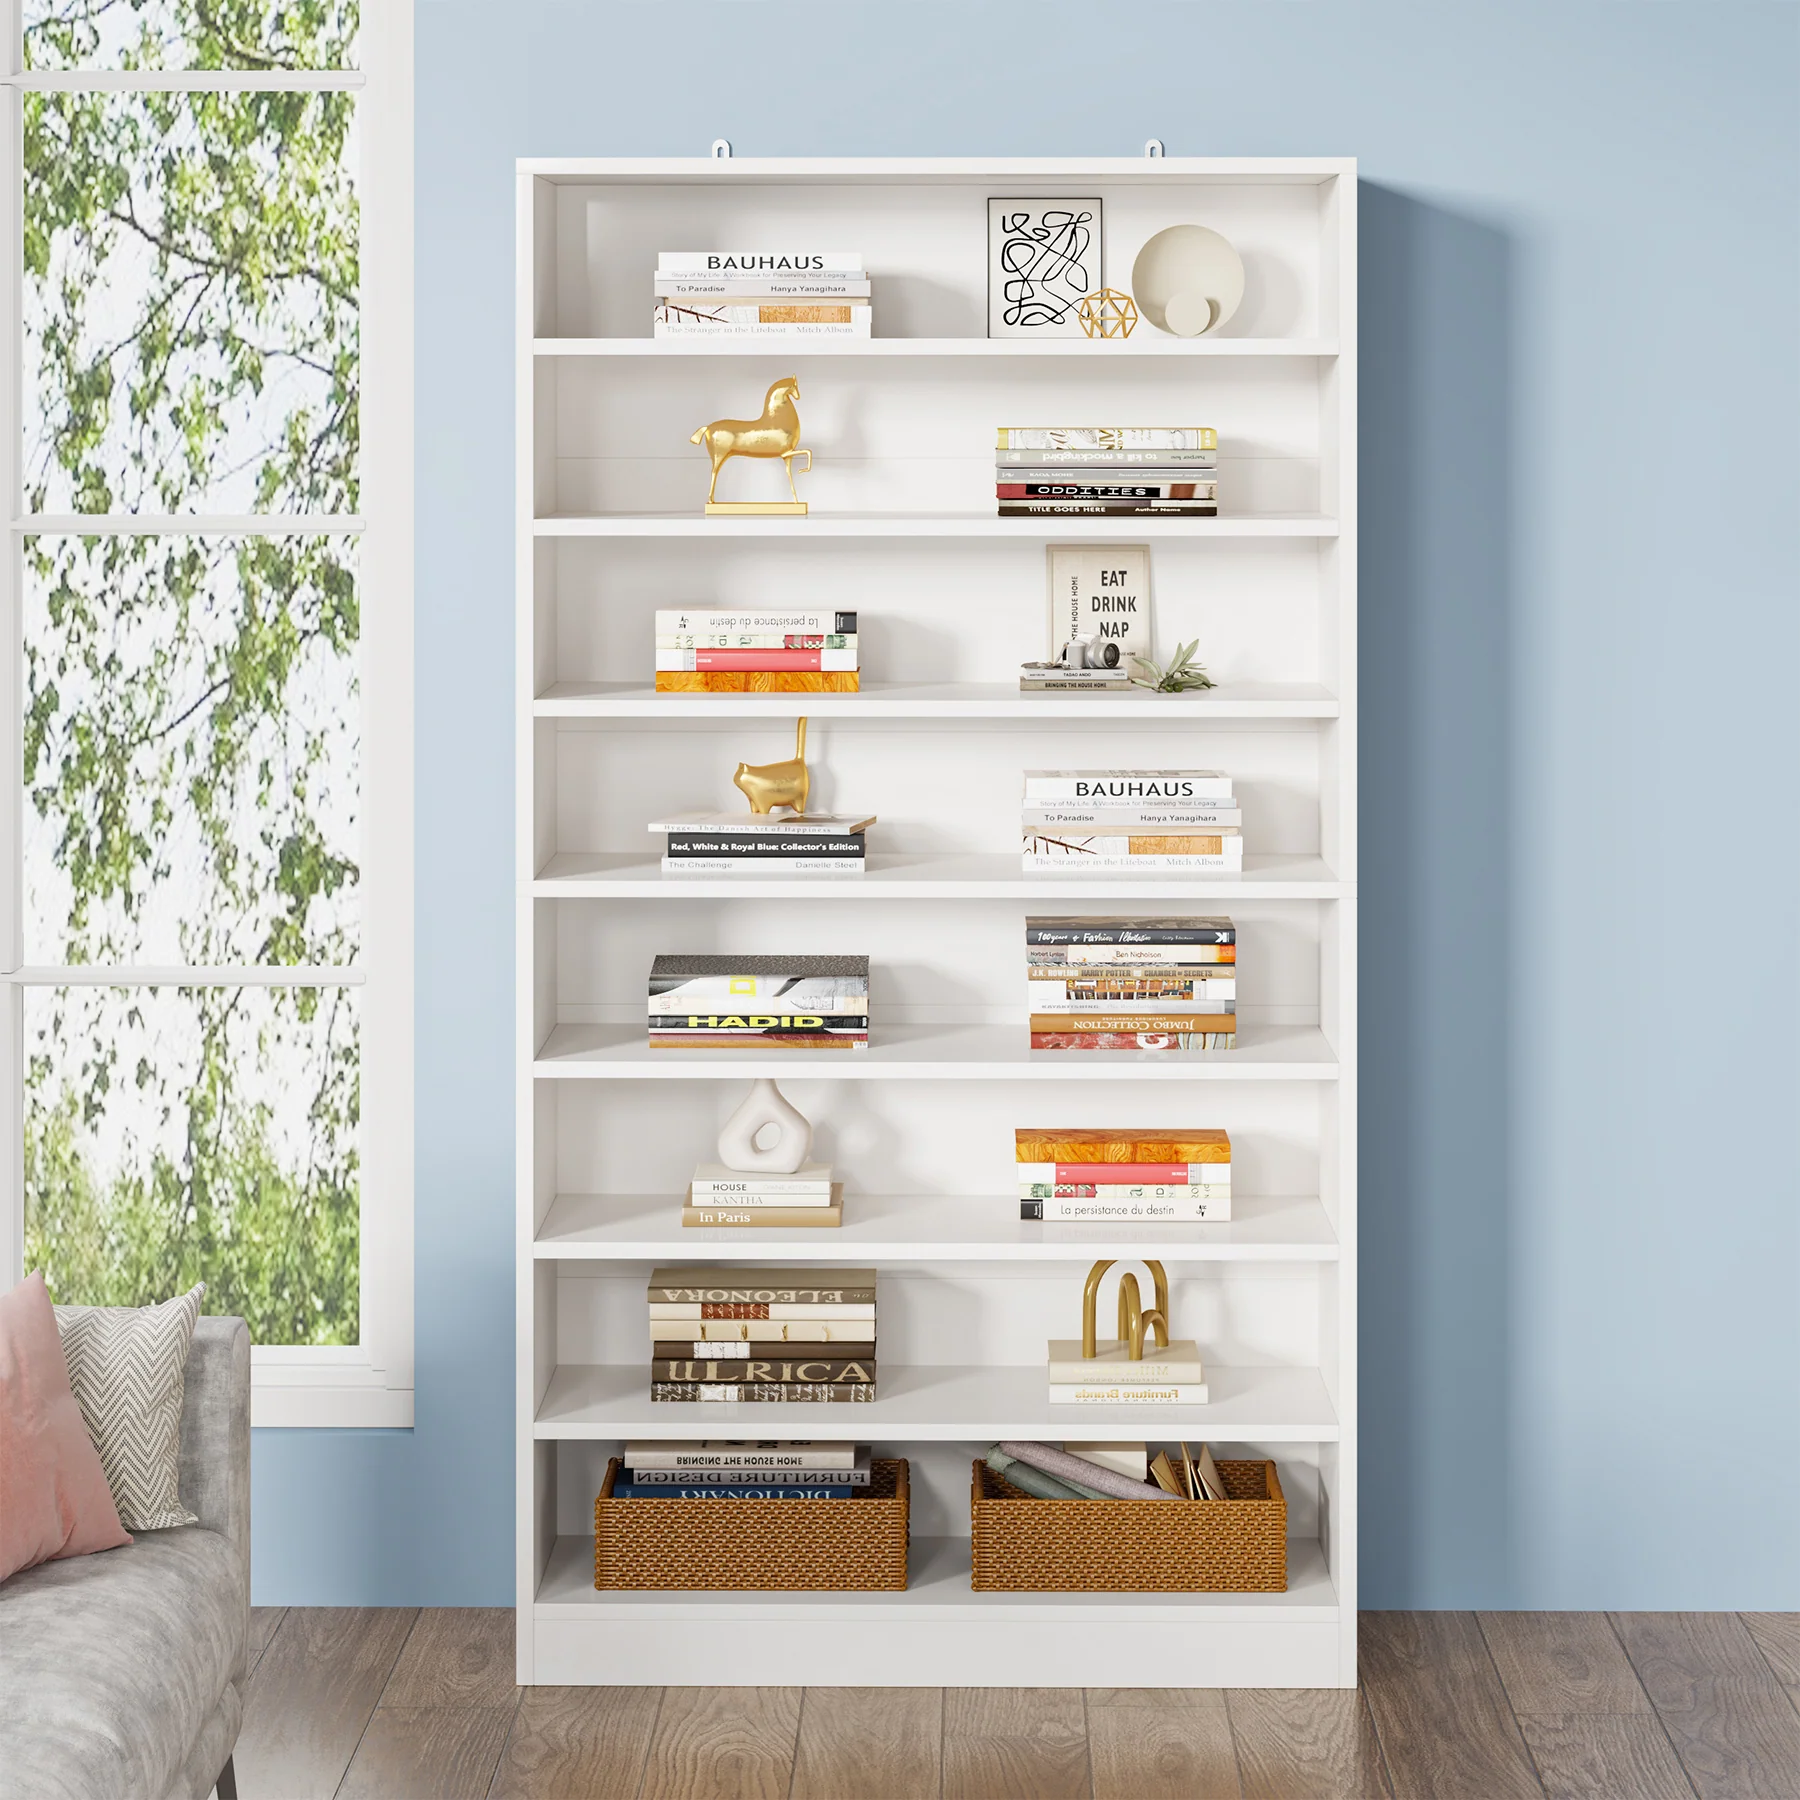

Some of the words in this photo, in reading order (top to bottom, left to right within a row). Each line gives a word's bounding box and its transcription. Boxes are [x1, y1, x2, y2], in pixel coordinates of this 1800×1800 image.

[707, 256, 824, 270] BAUHAUS
[771, 285, 797, 294] Hanya
[799, 285, 846, 294] Yanagihara
[667, 326, 682, 334] The
[684, 326, 721, 336] Stranger
[735, 326, 749, 334] the
[796, 326, 822, 334] Mitch
[1042, 452, 1113, 462] mockingbird
[1127, 453, 1143, 462] kill
[1037, 487, 1147, 496] ODDITIES
[1101, 571, 1127, 587] EAT
[1071, 576, 1079, 597] HOME
[1092, 596, 1137, 612] DRINK
[1071, 598, 1079, 622] HOUSE
[710, 617, 737, 628] destin
[739, 617, 751, 628] du
[754, 616, 806, 628] persistance
[808, 617, 819, 628] La
[1071, 623, 1079, 638] THE
[1100, 622, 1129, 638] NAP
[1076, 782, 1194, 796] BAUHAUS
[1140, 814, 1167, 823] Hanya
[1168, 814, 1217, 823] Yanagihara
[671, 843, 690, 852] Red,
[692, 843, 719, 851] White
[720, 843, 730, 851] &
[731, 843, 755, 853] Royal
[757, 843, 779, 851] Blue:
[781, 843, 827, 851] Collector's
[829, 843, 860, 851] Edition
[668, 861, 685, 869] The
[687, 861, 733, 871] Challenge
[795, 861, 832, 869] Danielle
[834, 861, 858, 869] Steel
[1035, 858, 1050, 866] The
[1052, 858, 1089, 867] Stranger
[1104, 858, 1118, 866] the
[1120, 858, 1157, 866] Lifeboat
[1166, 858, 1192, 866] Mitch
[1194, 858, 1224, 866] Albom
[1115, 950, 1129, 958] Ben
[1130, 950, 1162, 958] Nicholson
[1032, 969, 1046, 977] J.K.
[1048, 969, 1079, 977] ROWLING
[1081, 969, 1104, 977] HARRY
[1105, 969, 1131, 977] POTTER
[1144, 969, 1177, 977] CHAMBER
[1183, 969, 1213, 977] SECRETS
[687, 1016, 824, 1028] HADID
[1073, 1021, 1150, 1031] COLLECTION
[1153, 1019, 1195, 1031] JUMBO
[712, 1183, 747, 1192] HOUSE
[713, 1196, 763, 1205] KANTHA
[1060, 1204, 1071, 1215] La
[1074, 1204, 1129, 1217] persistance
[1131, 1204, 1144, 1215] du
[1146, 1204, 1175, 1215] destin
[700, 1212, 714, 1223] In
[717, 1212, 751, 1223] Paris
[662, 1289, 844, 1303] ELEONORA
